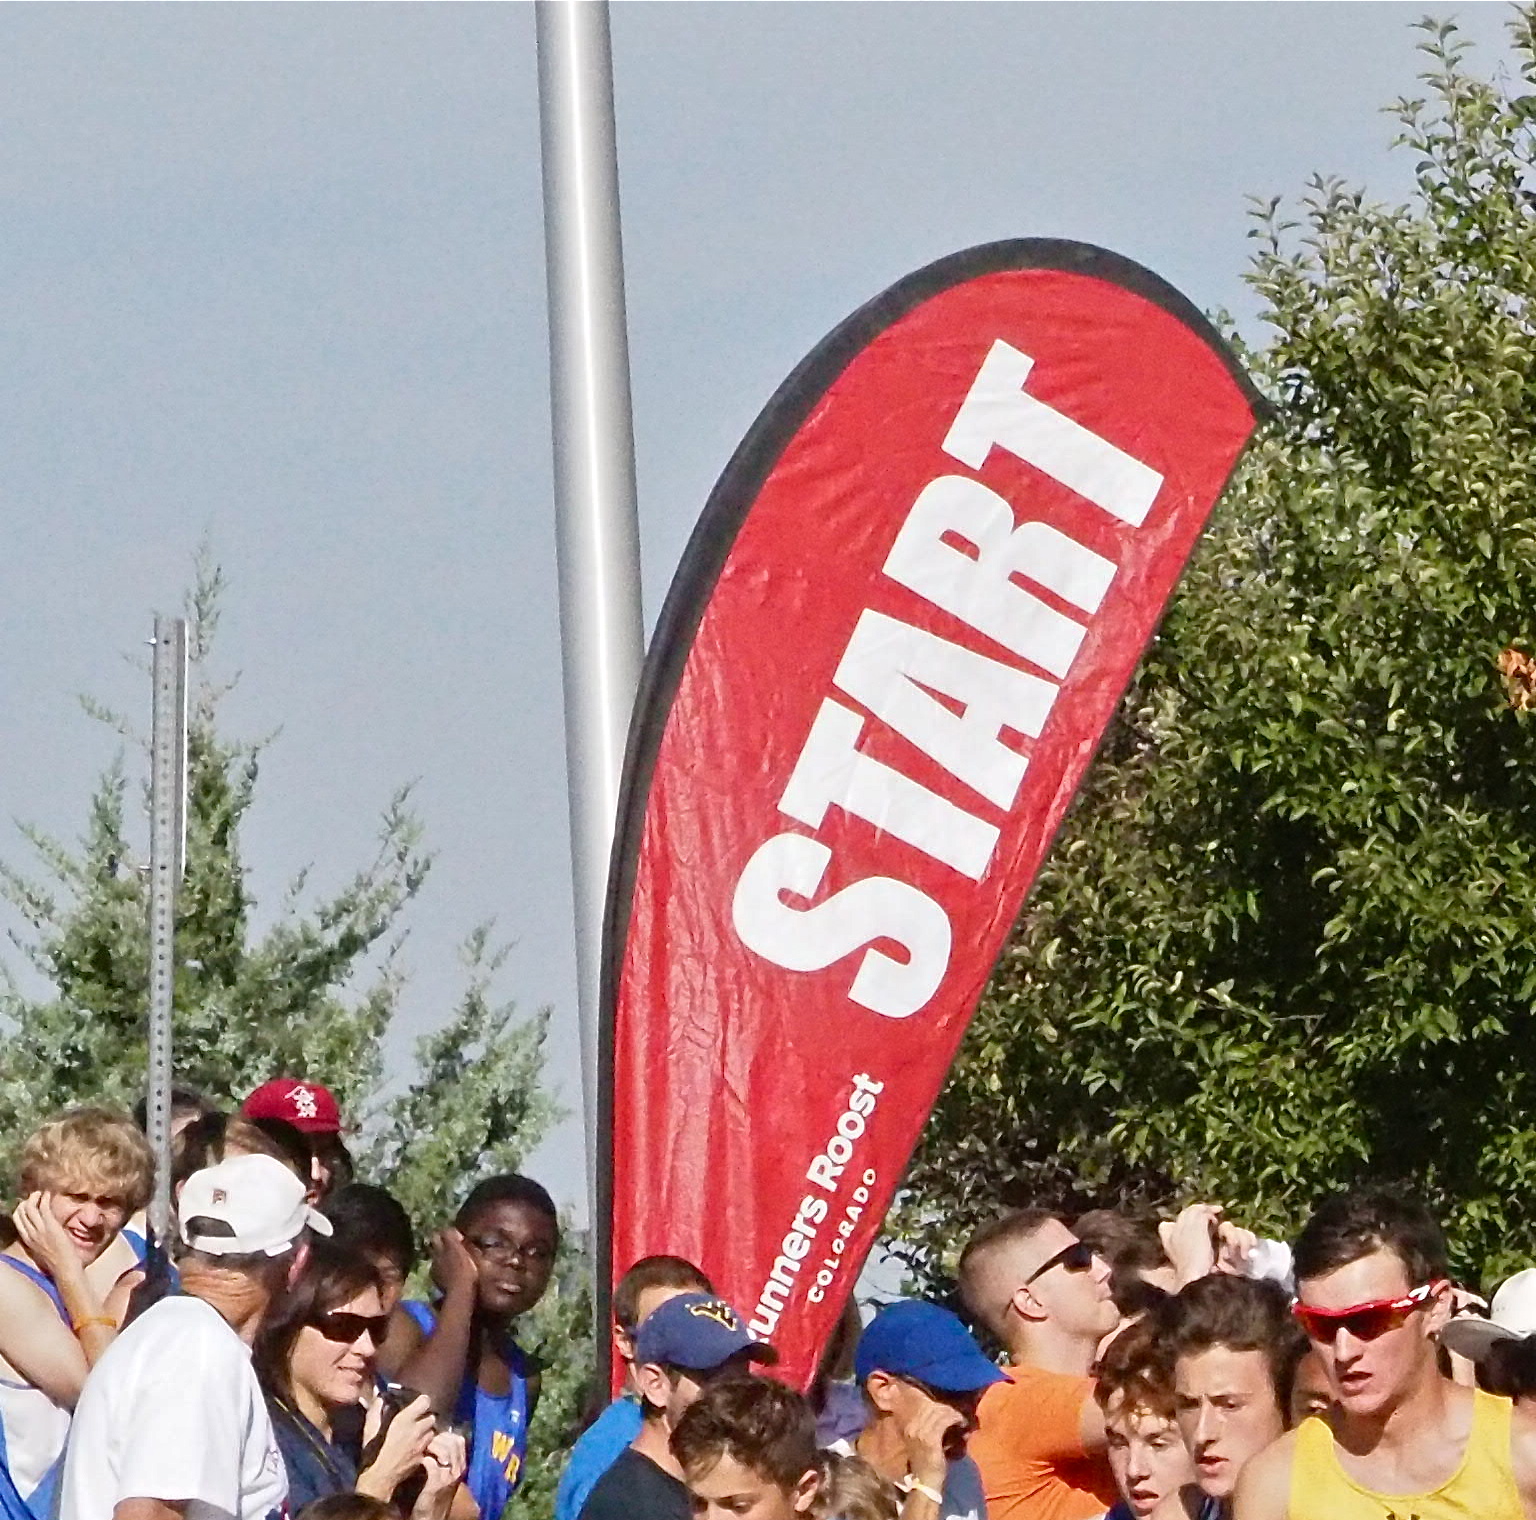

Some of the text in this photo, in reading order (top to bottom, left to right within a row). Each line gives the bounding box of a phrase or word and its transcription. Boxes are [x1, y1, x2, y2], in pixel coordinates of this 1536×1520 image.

[732, 338, 1165, 1020] START
[806, 1072, 884, 1193] Roost
[807, 1168, 877, 1304] COLORADO
